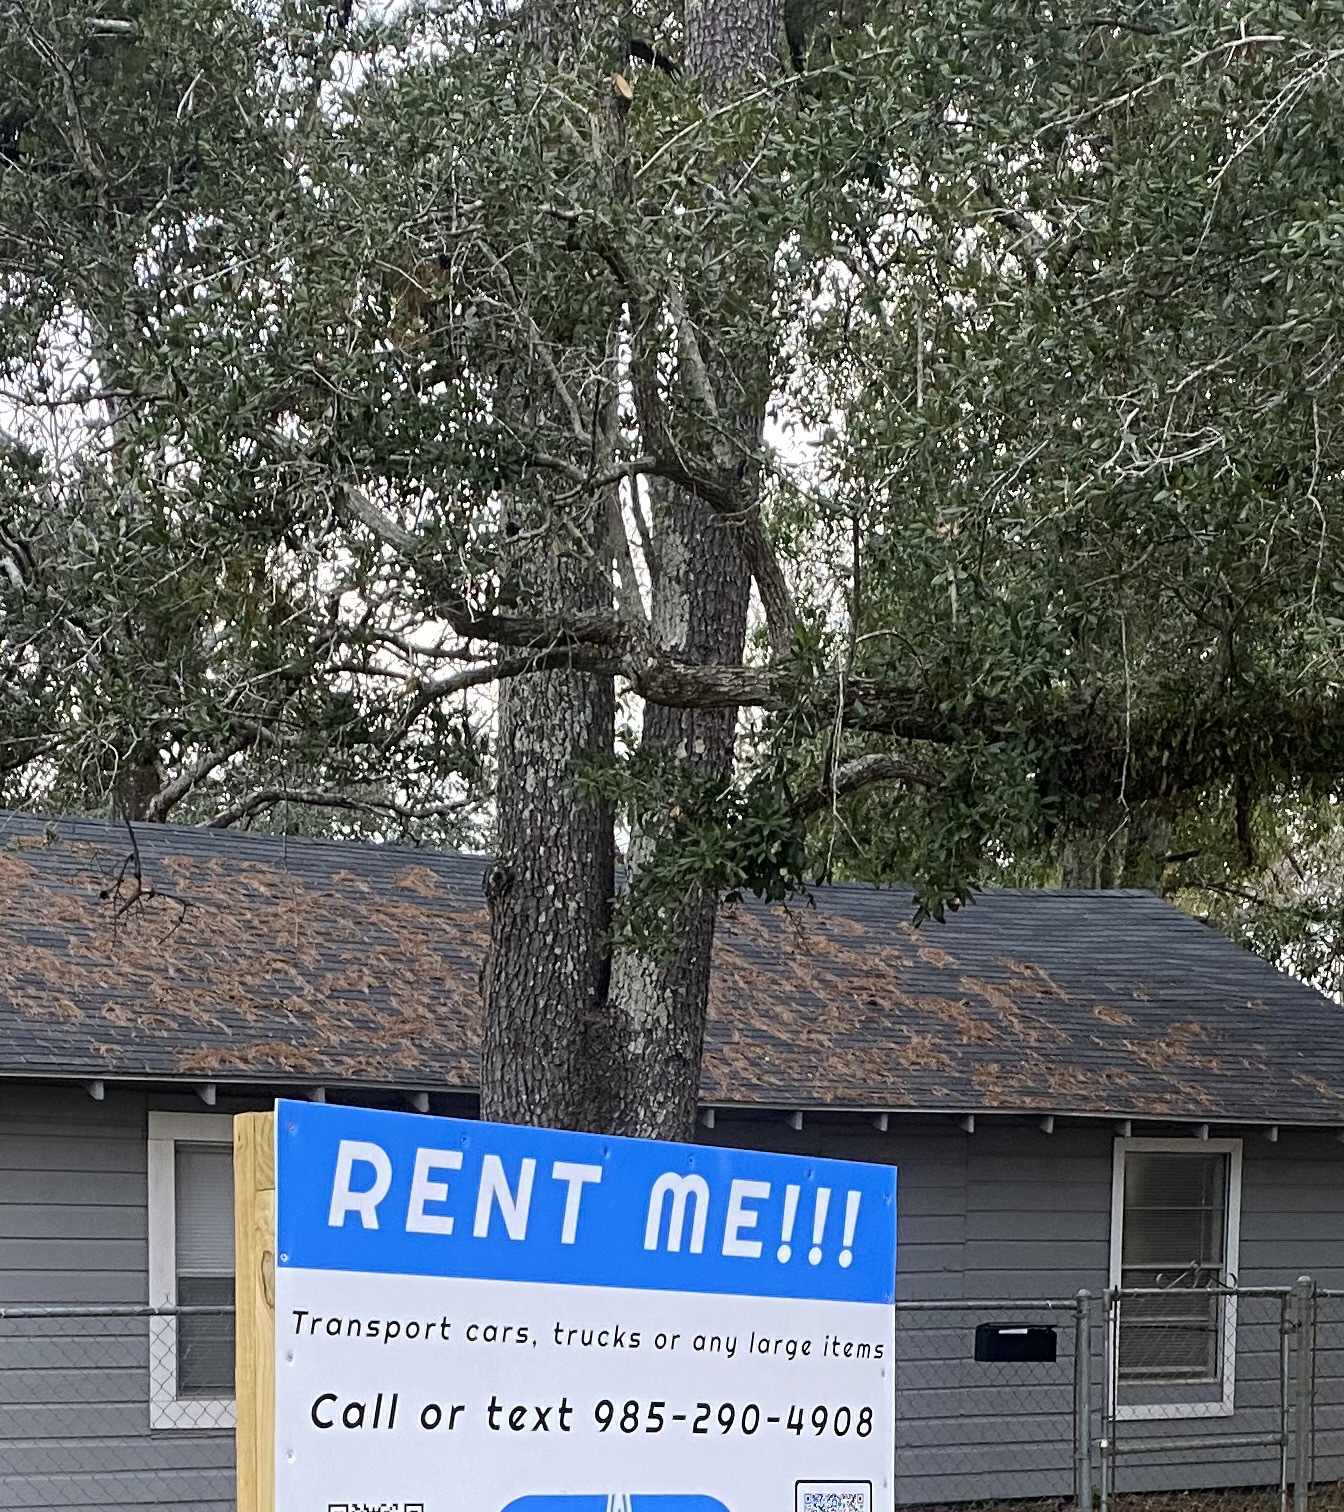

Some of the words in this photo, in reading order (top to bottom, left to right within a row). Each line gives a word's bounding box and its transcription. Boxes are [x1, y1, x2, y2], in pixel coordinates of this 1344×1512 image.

[329, 1140, 603, 1245] RENT
[644, 1172, 862, 1268] ME!!!
[293, 1311, 452, 1345] Transport
[467, 1325, 537, 1348] cars,
[554, 1322, 641, 1349] trucks
[654, 1333, 681, 1350] or
[693, 1335, 737, 1359] any
[749, 1331, 812, 1360] large
[823, 1335, 884, 1359] items
[311, 1393, 399, 1430] Call
[420, 1403, 466, 1430] or
[487, 1396, 573, 1432] text
[594, 1400, 873, 1438] 985-290-4908
